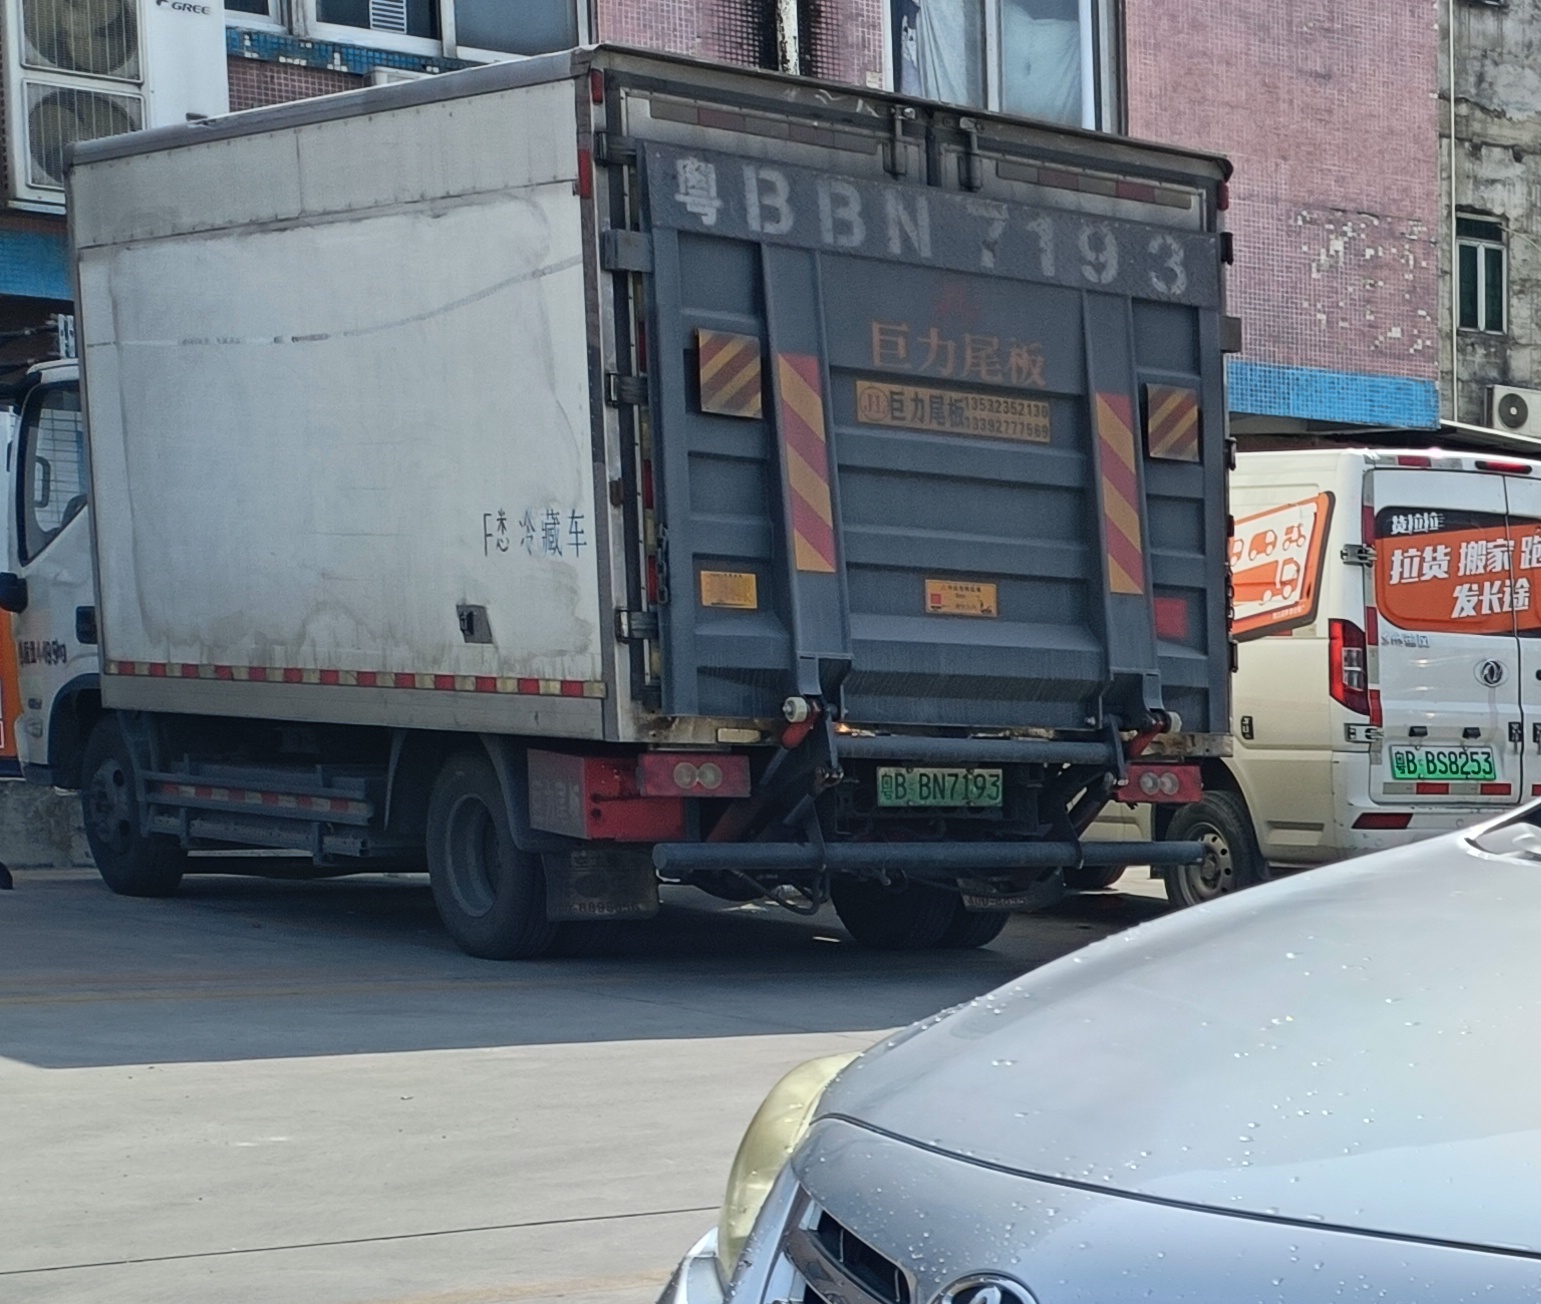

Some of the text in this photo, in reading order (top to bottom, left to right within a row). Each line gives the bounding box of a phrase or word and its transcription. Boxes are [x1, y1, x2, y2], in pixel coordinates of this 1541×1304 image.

[171, 1, 211, 15] GREE
[871, 320, 1046, 388] 巨力尾板
[889, 390, 966, 430] 巨力尾板
[1389, 544, 1452, 585] 拉货
[1457, 537, 1515, 577] 搬家
[1451, 578, 1530, 619] 发长途
